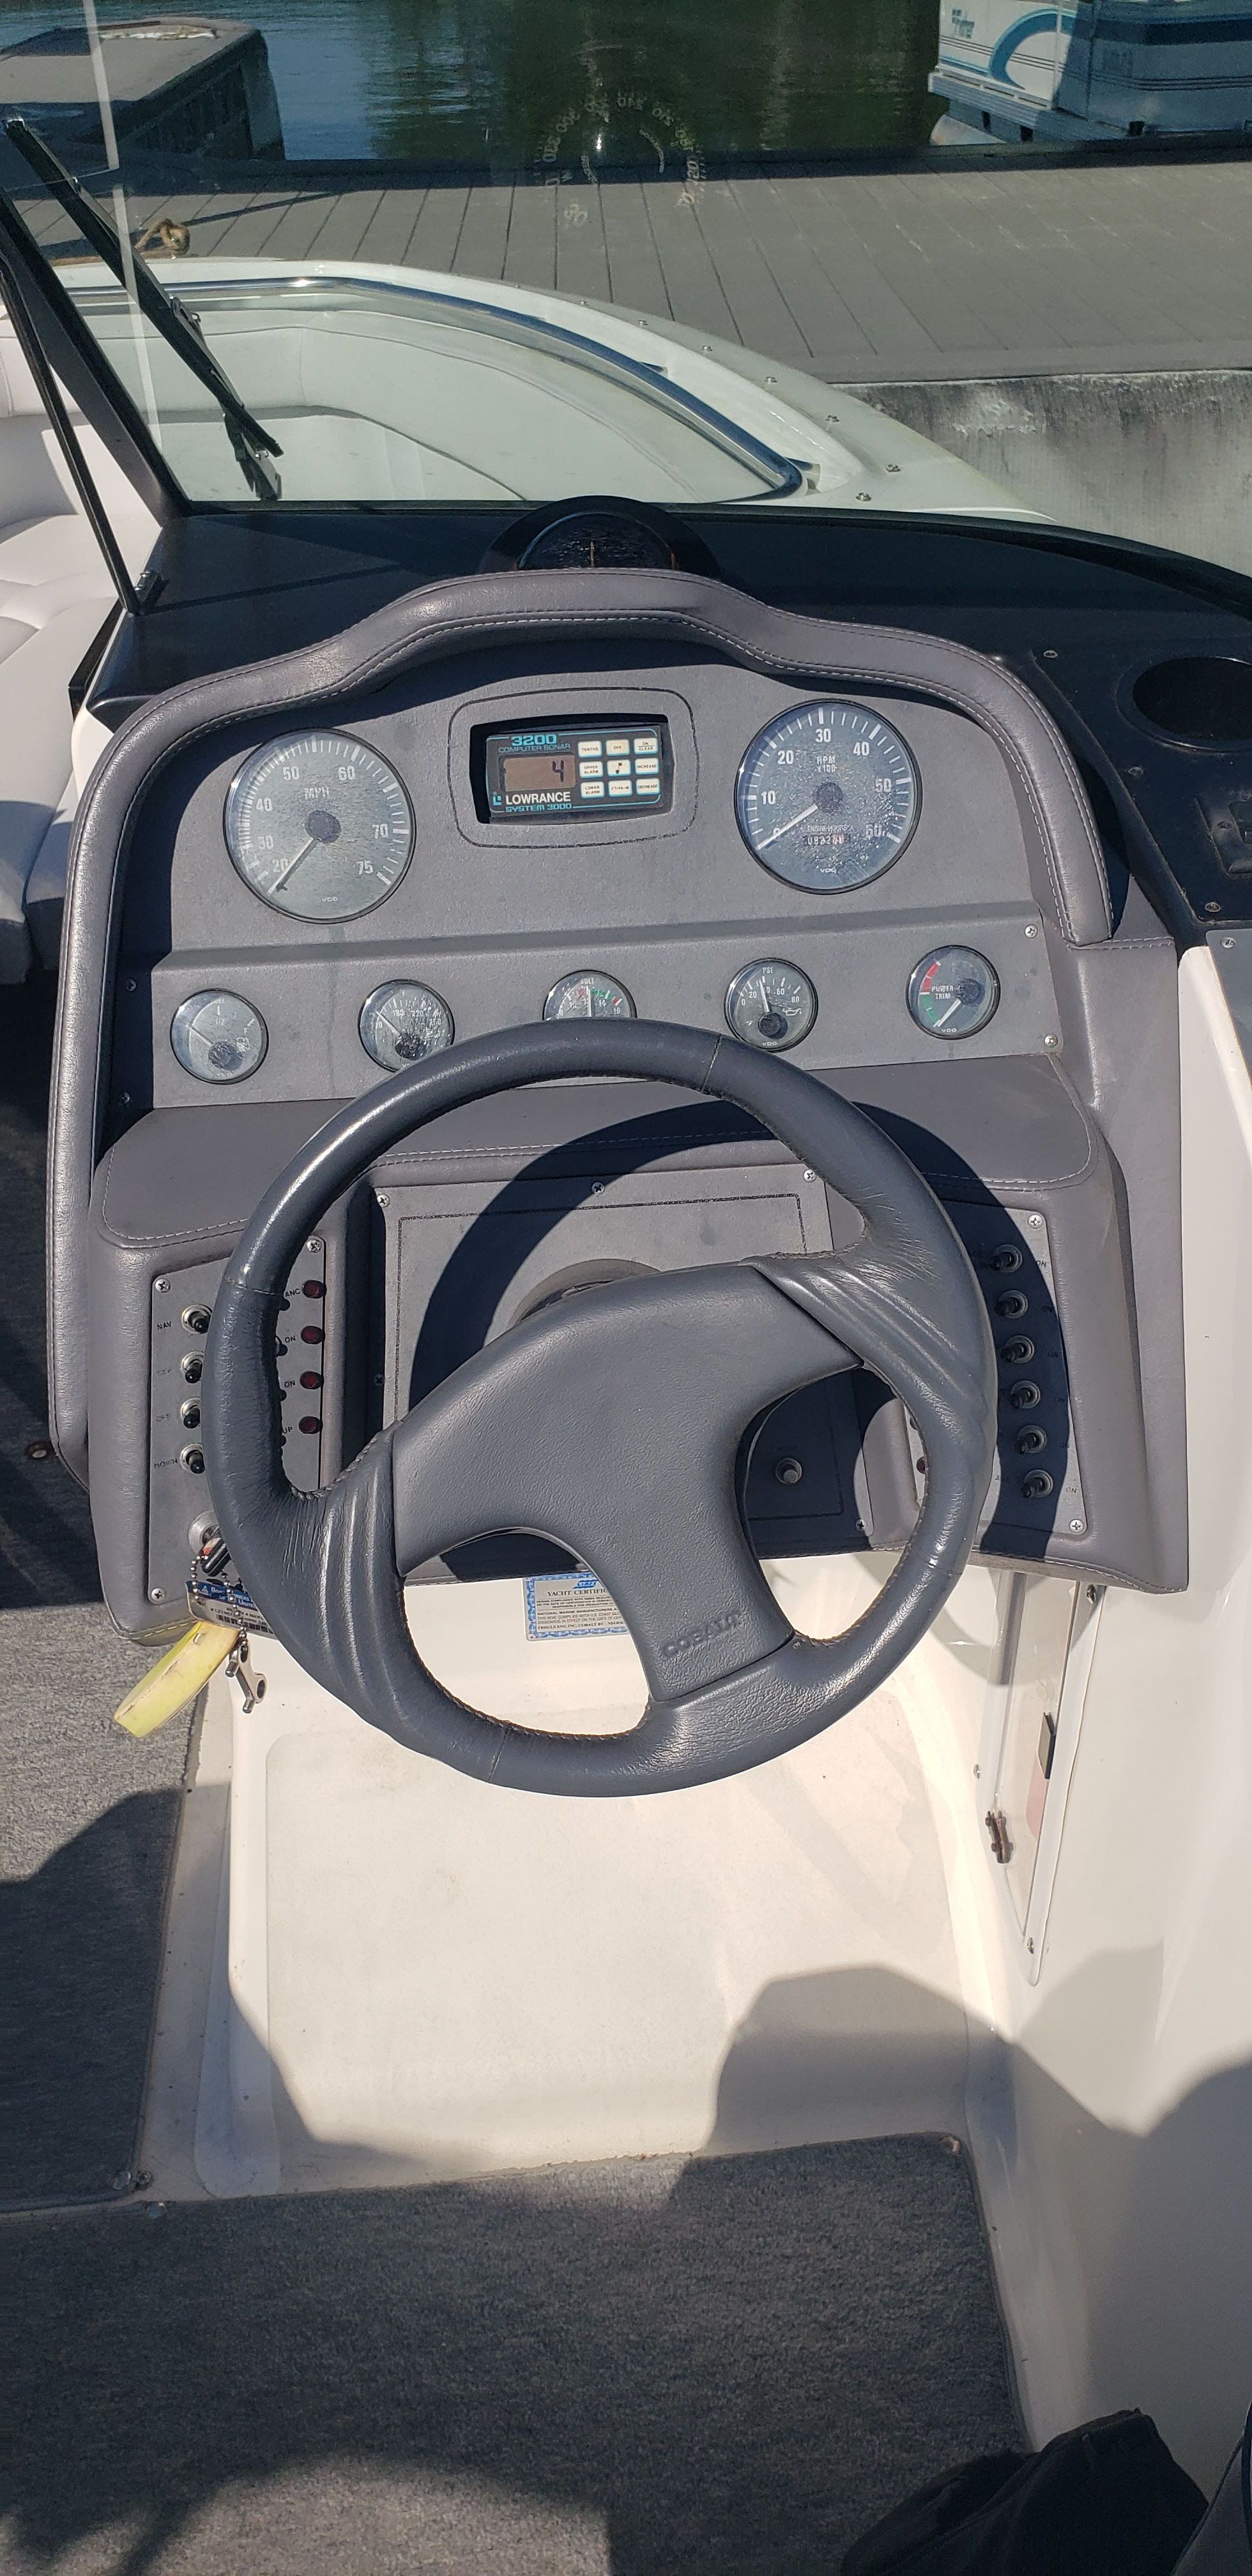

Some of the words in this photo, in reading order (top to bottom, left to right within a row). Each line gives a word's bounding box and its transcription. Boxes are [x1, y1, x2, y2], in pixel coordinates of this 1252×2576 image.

[511, 734, 557, 746] 3200
[815, 729, 831, 742] 30
[853, 742, 869, 756] 40
[777, 750, 794, 765] 20
[282, 766, 300, 781] 50
[338, 765, 355, 781] 60
[552, 760, 564, 782] 4
[875, 778, 892, 792] 50
[256, 798, 273, 811] 40
[506, 792, 571, 805] LOWRANCE
[761, 790, 776, 805] 10
[372, 824, 388, 839] 70
[258, 834, 274, 849] 30
[272, 857, 287, 873] 20
[356, 860, 373, 875] 75
[285, 1289, 301, 1298] ANC
